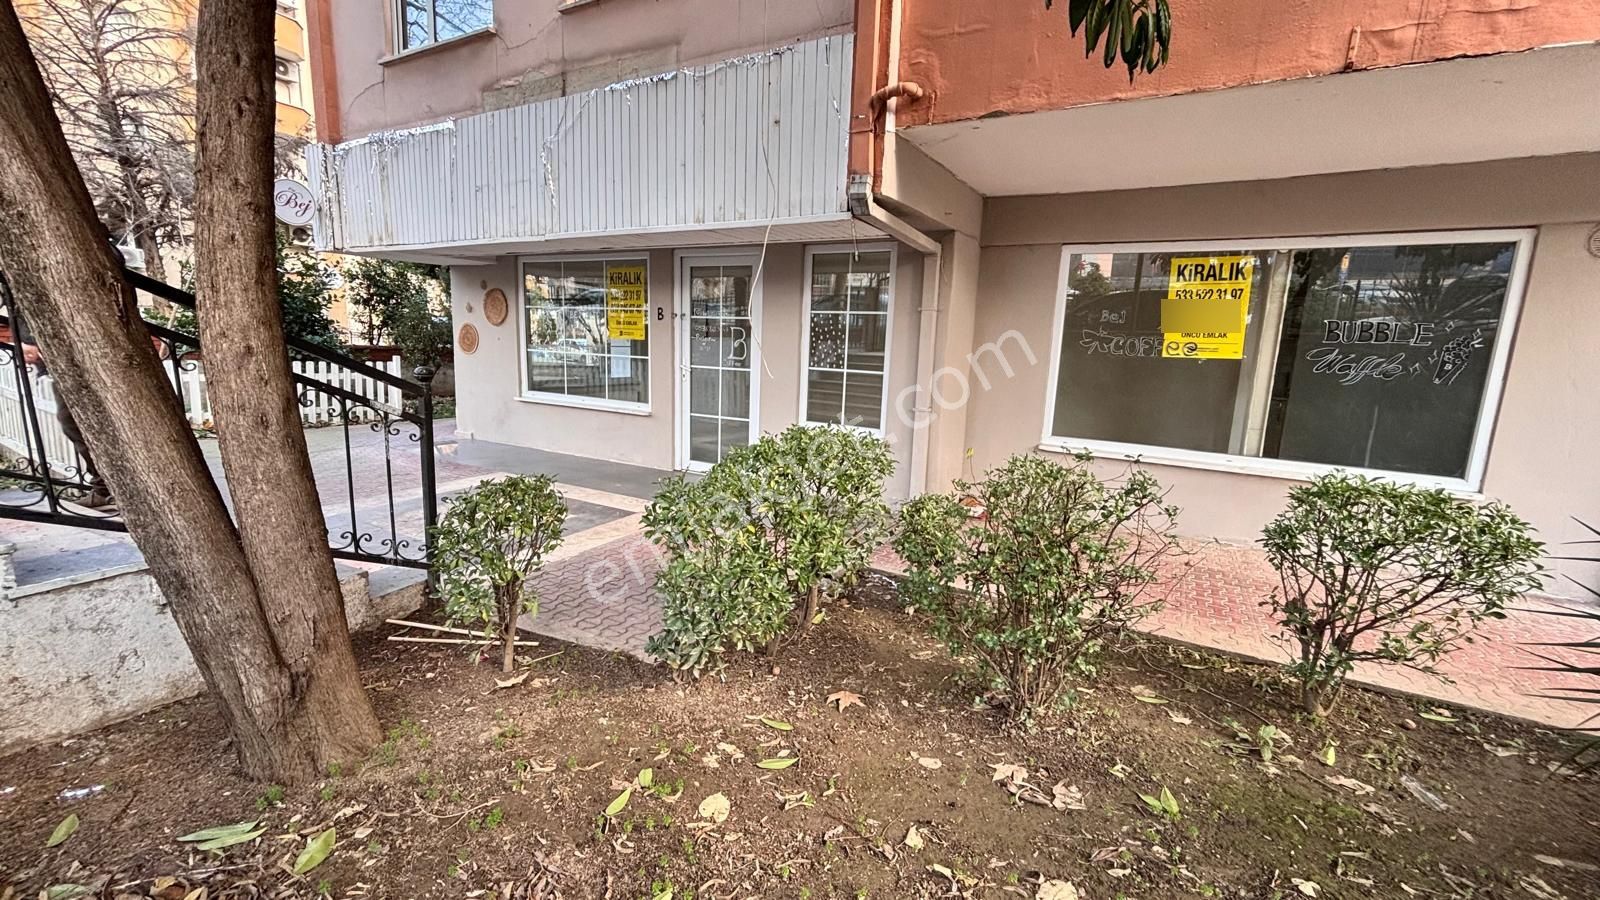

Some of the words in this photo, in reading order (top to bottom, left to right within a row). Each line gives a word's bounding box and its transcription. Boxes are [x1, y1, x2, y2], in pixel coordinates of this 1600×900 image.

[275, 190, 312, 217] Bej
[657, 306, 664, 320] B
[727, 326, 747, 360] B
[1322, 319, 1435, 347] BUBBLE
